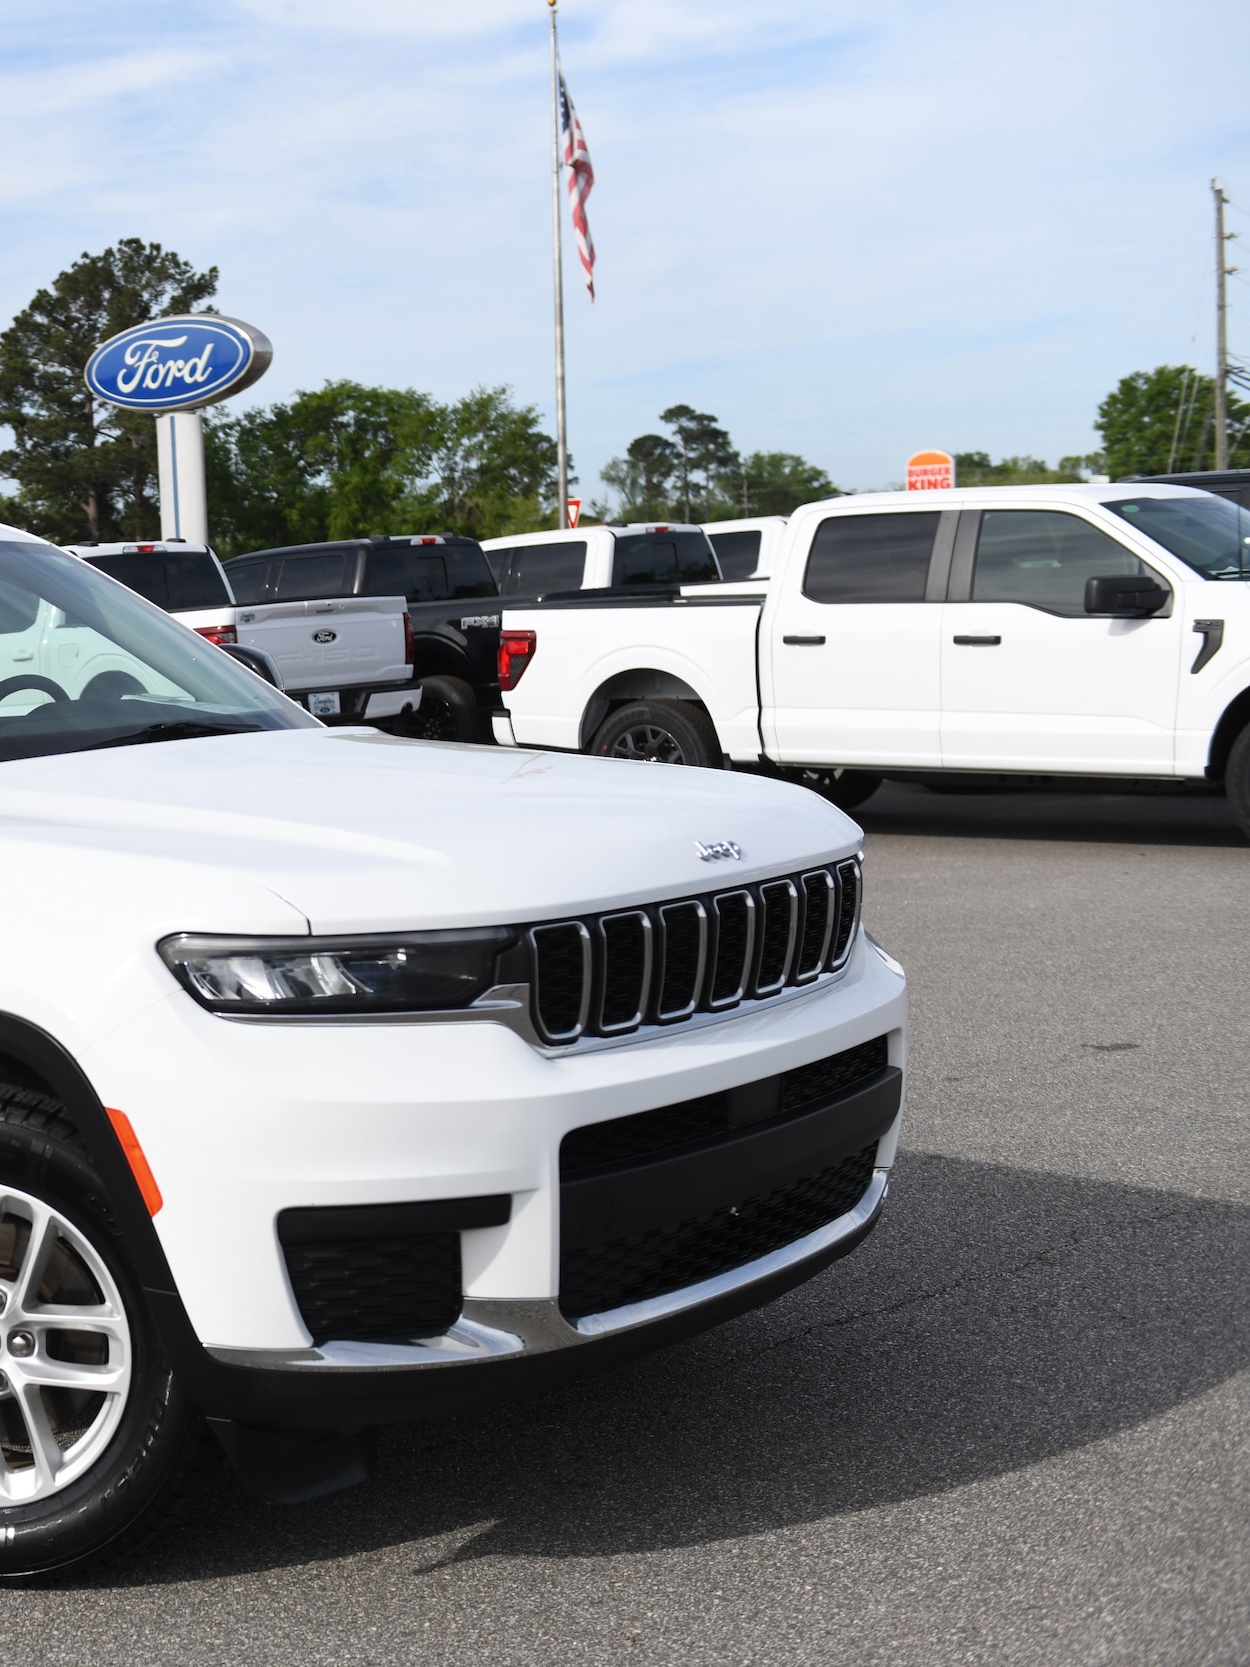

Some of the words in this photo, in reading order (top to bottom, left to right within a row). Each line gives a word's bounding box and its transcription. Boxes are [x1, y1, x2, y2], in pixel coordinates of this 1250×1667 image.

[117, 335, 215, 393] Ford
[908, 467, 951, 477] BURGER
[908, 477, 951, 491] KING
[461, 615, 500, 630] FX4
[694, 841, 742, 862] Jeep
